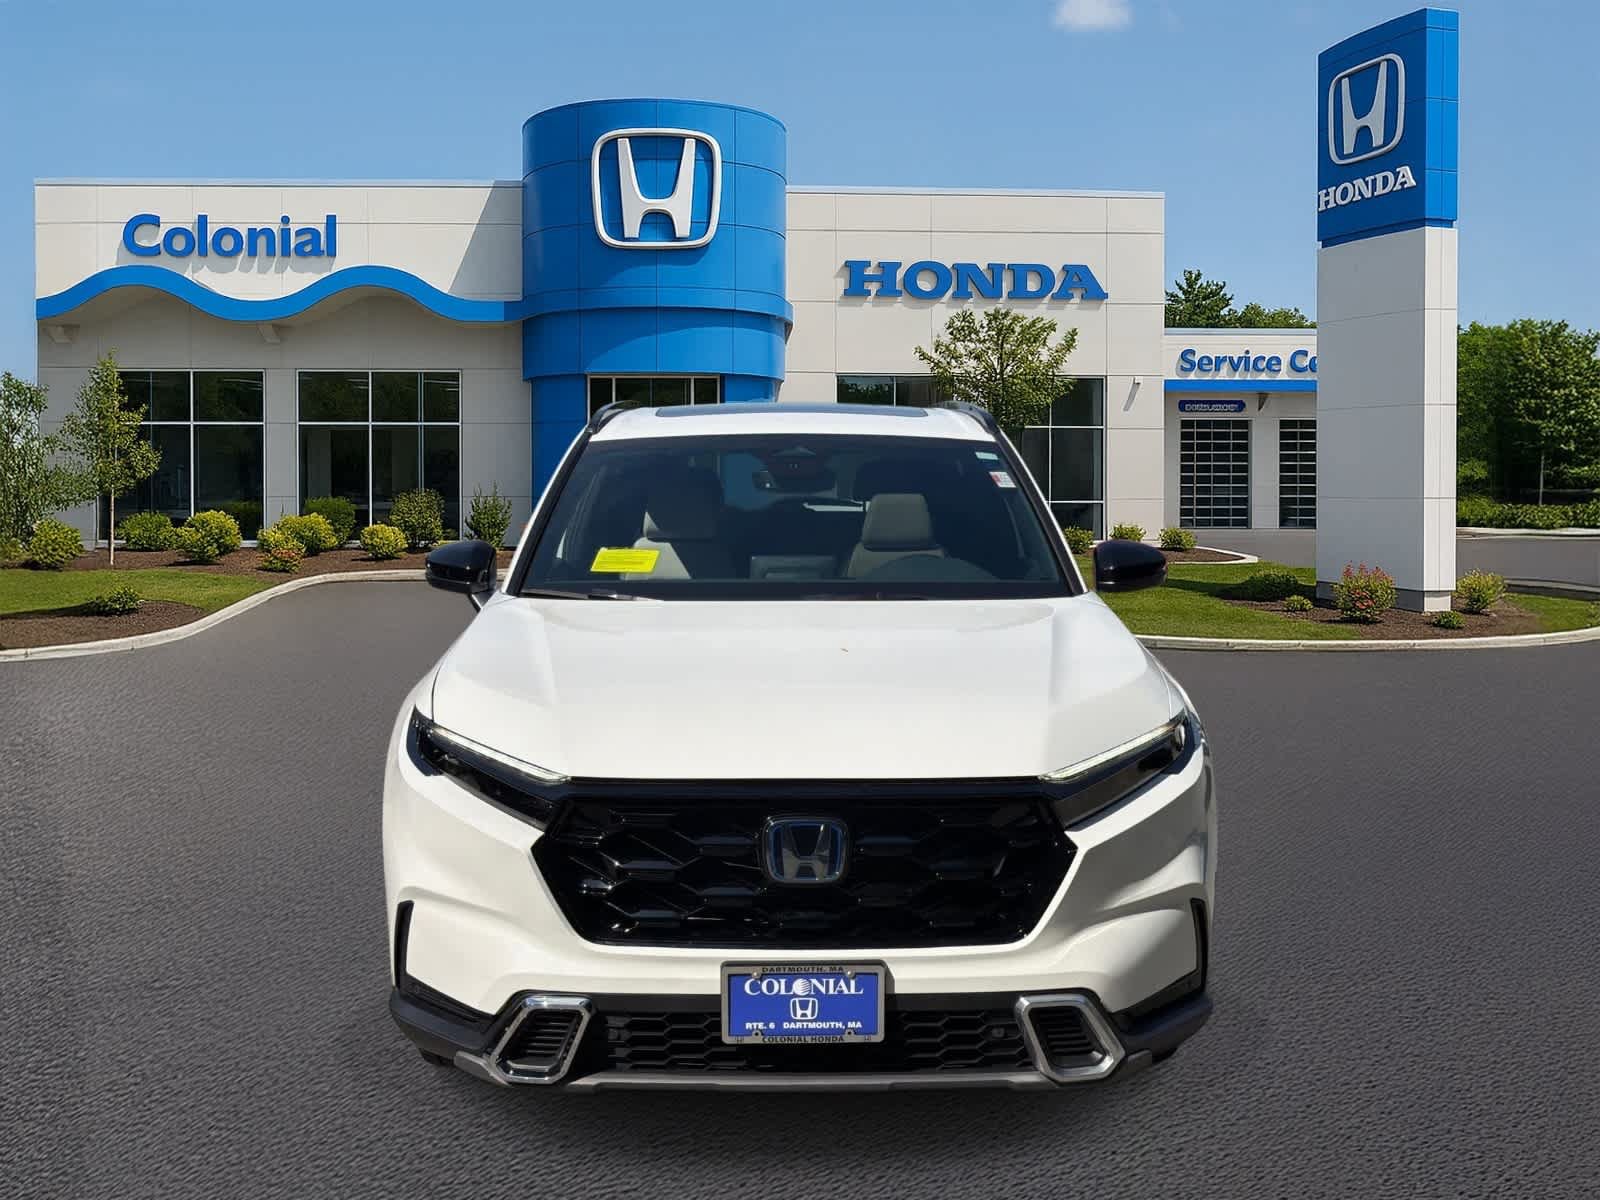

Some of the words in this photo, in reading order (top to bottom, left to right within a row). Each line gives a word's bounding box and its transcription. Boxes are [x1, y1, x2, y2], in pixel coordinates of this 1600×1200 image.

[1318, 165, 1417, 212] HONDA
[123, 213, 337, 257] Colonial
[843, 260, 1108, 300] HONDA
[1180, 348, 1281, 373] Service
[744, 978, 864, 996] COLONIAL
[745, 1022, 767, 1030] RTE.
[768, 1022, 775, 1030] 6
[783, 1021, 846, 1030] DARTMOUTH,
[847, 1021, 862, 1029] MA
[811, 1035, 844, 1043] HONDA
